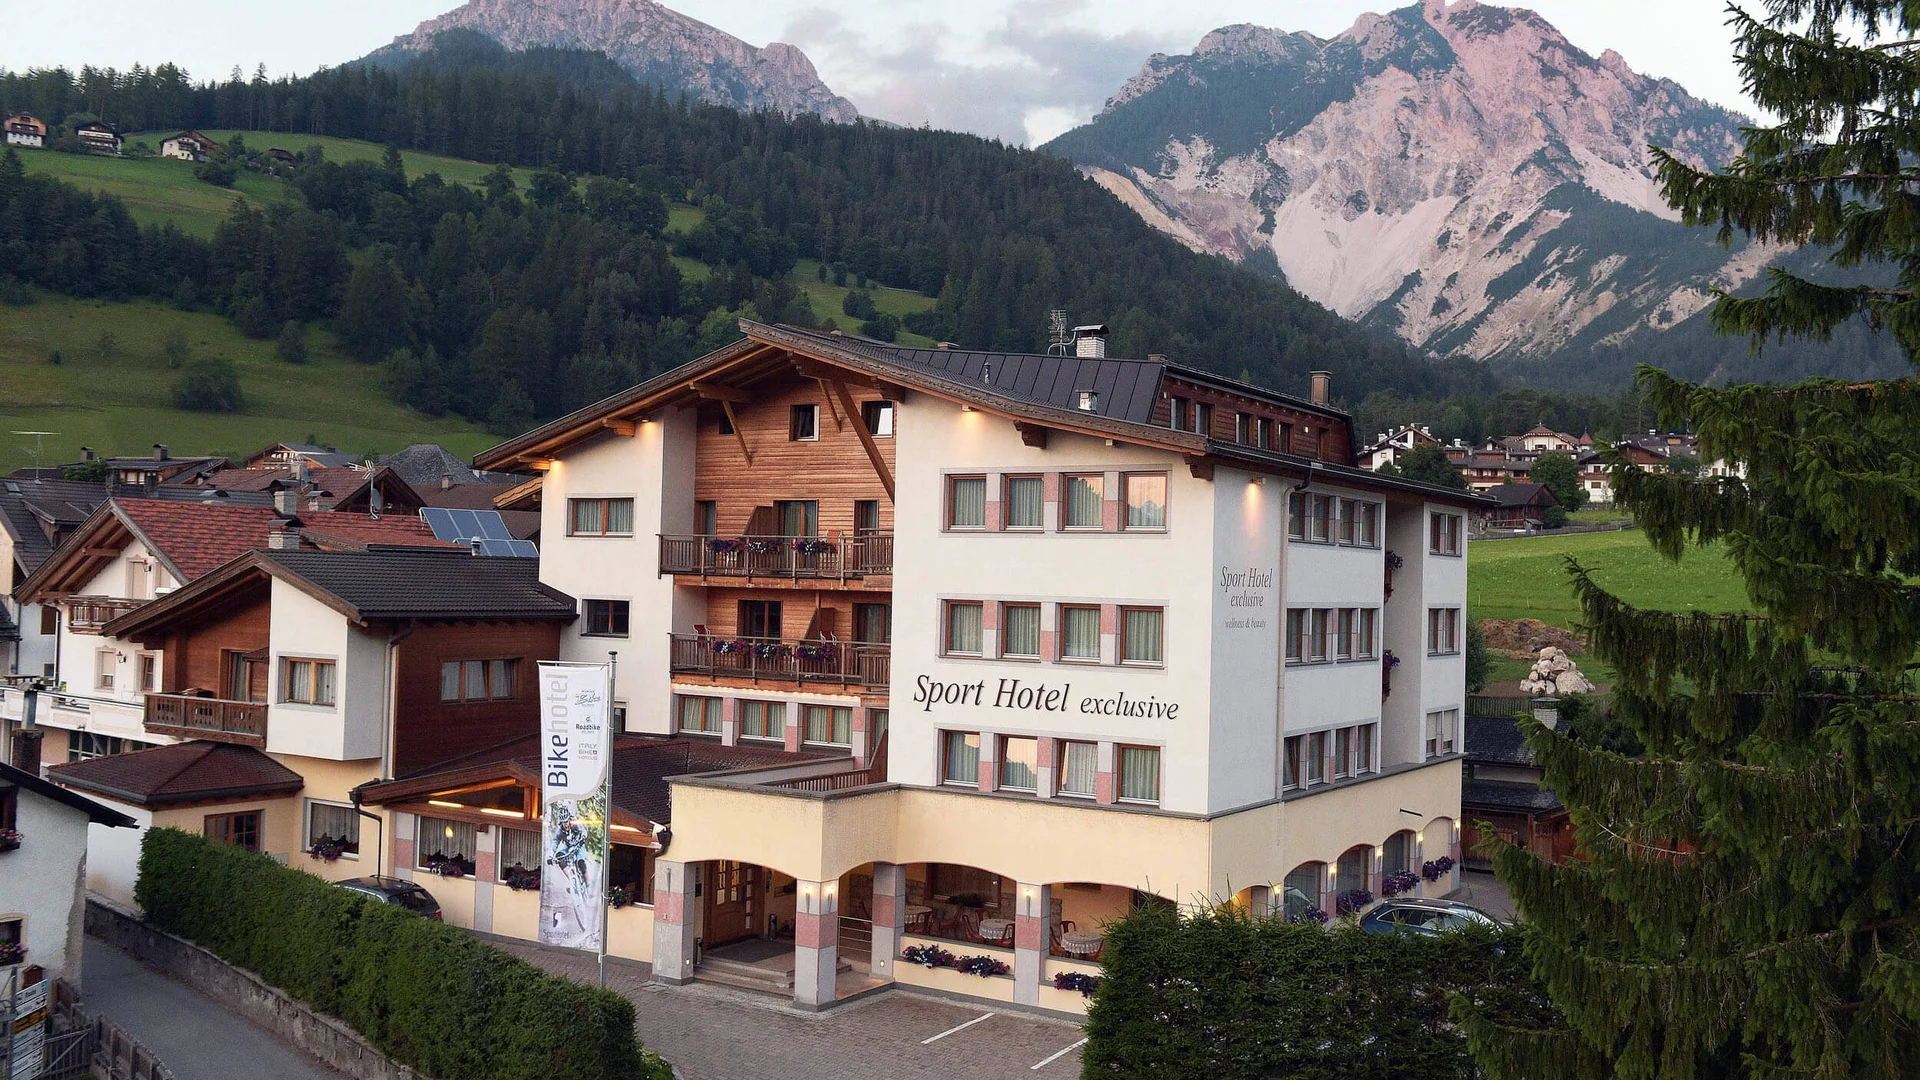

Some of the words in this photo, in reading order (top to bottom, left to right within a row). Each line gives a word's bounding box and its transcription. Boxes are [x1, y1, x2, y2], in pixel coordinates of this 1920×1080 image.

[1220, 566, 1246, 593] Sport
[1247, 567, 1273, 588] Hotel
[1230, 590, 1264, 607] exclusive
[1224, 617, 1245, 629] wellness
[1245, 617, 1250, 629] &
[1250, 617, 1267, 631] beauty
[913, 674, 985, 713] Sport
[993, 678, 1070, 712] Hotel
[1080, 692, 1179, 720] exclusive
[545, 673, 569, 788] Bikehotel
[575, 723, 601, 731] Roadbike
